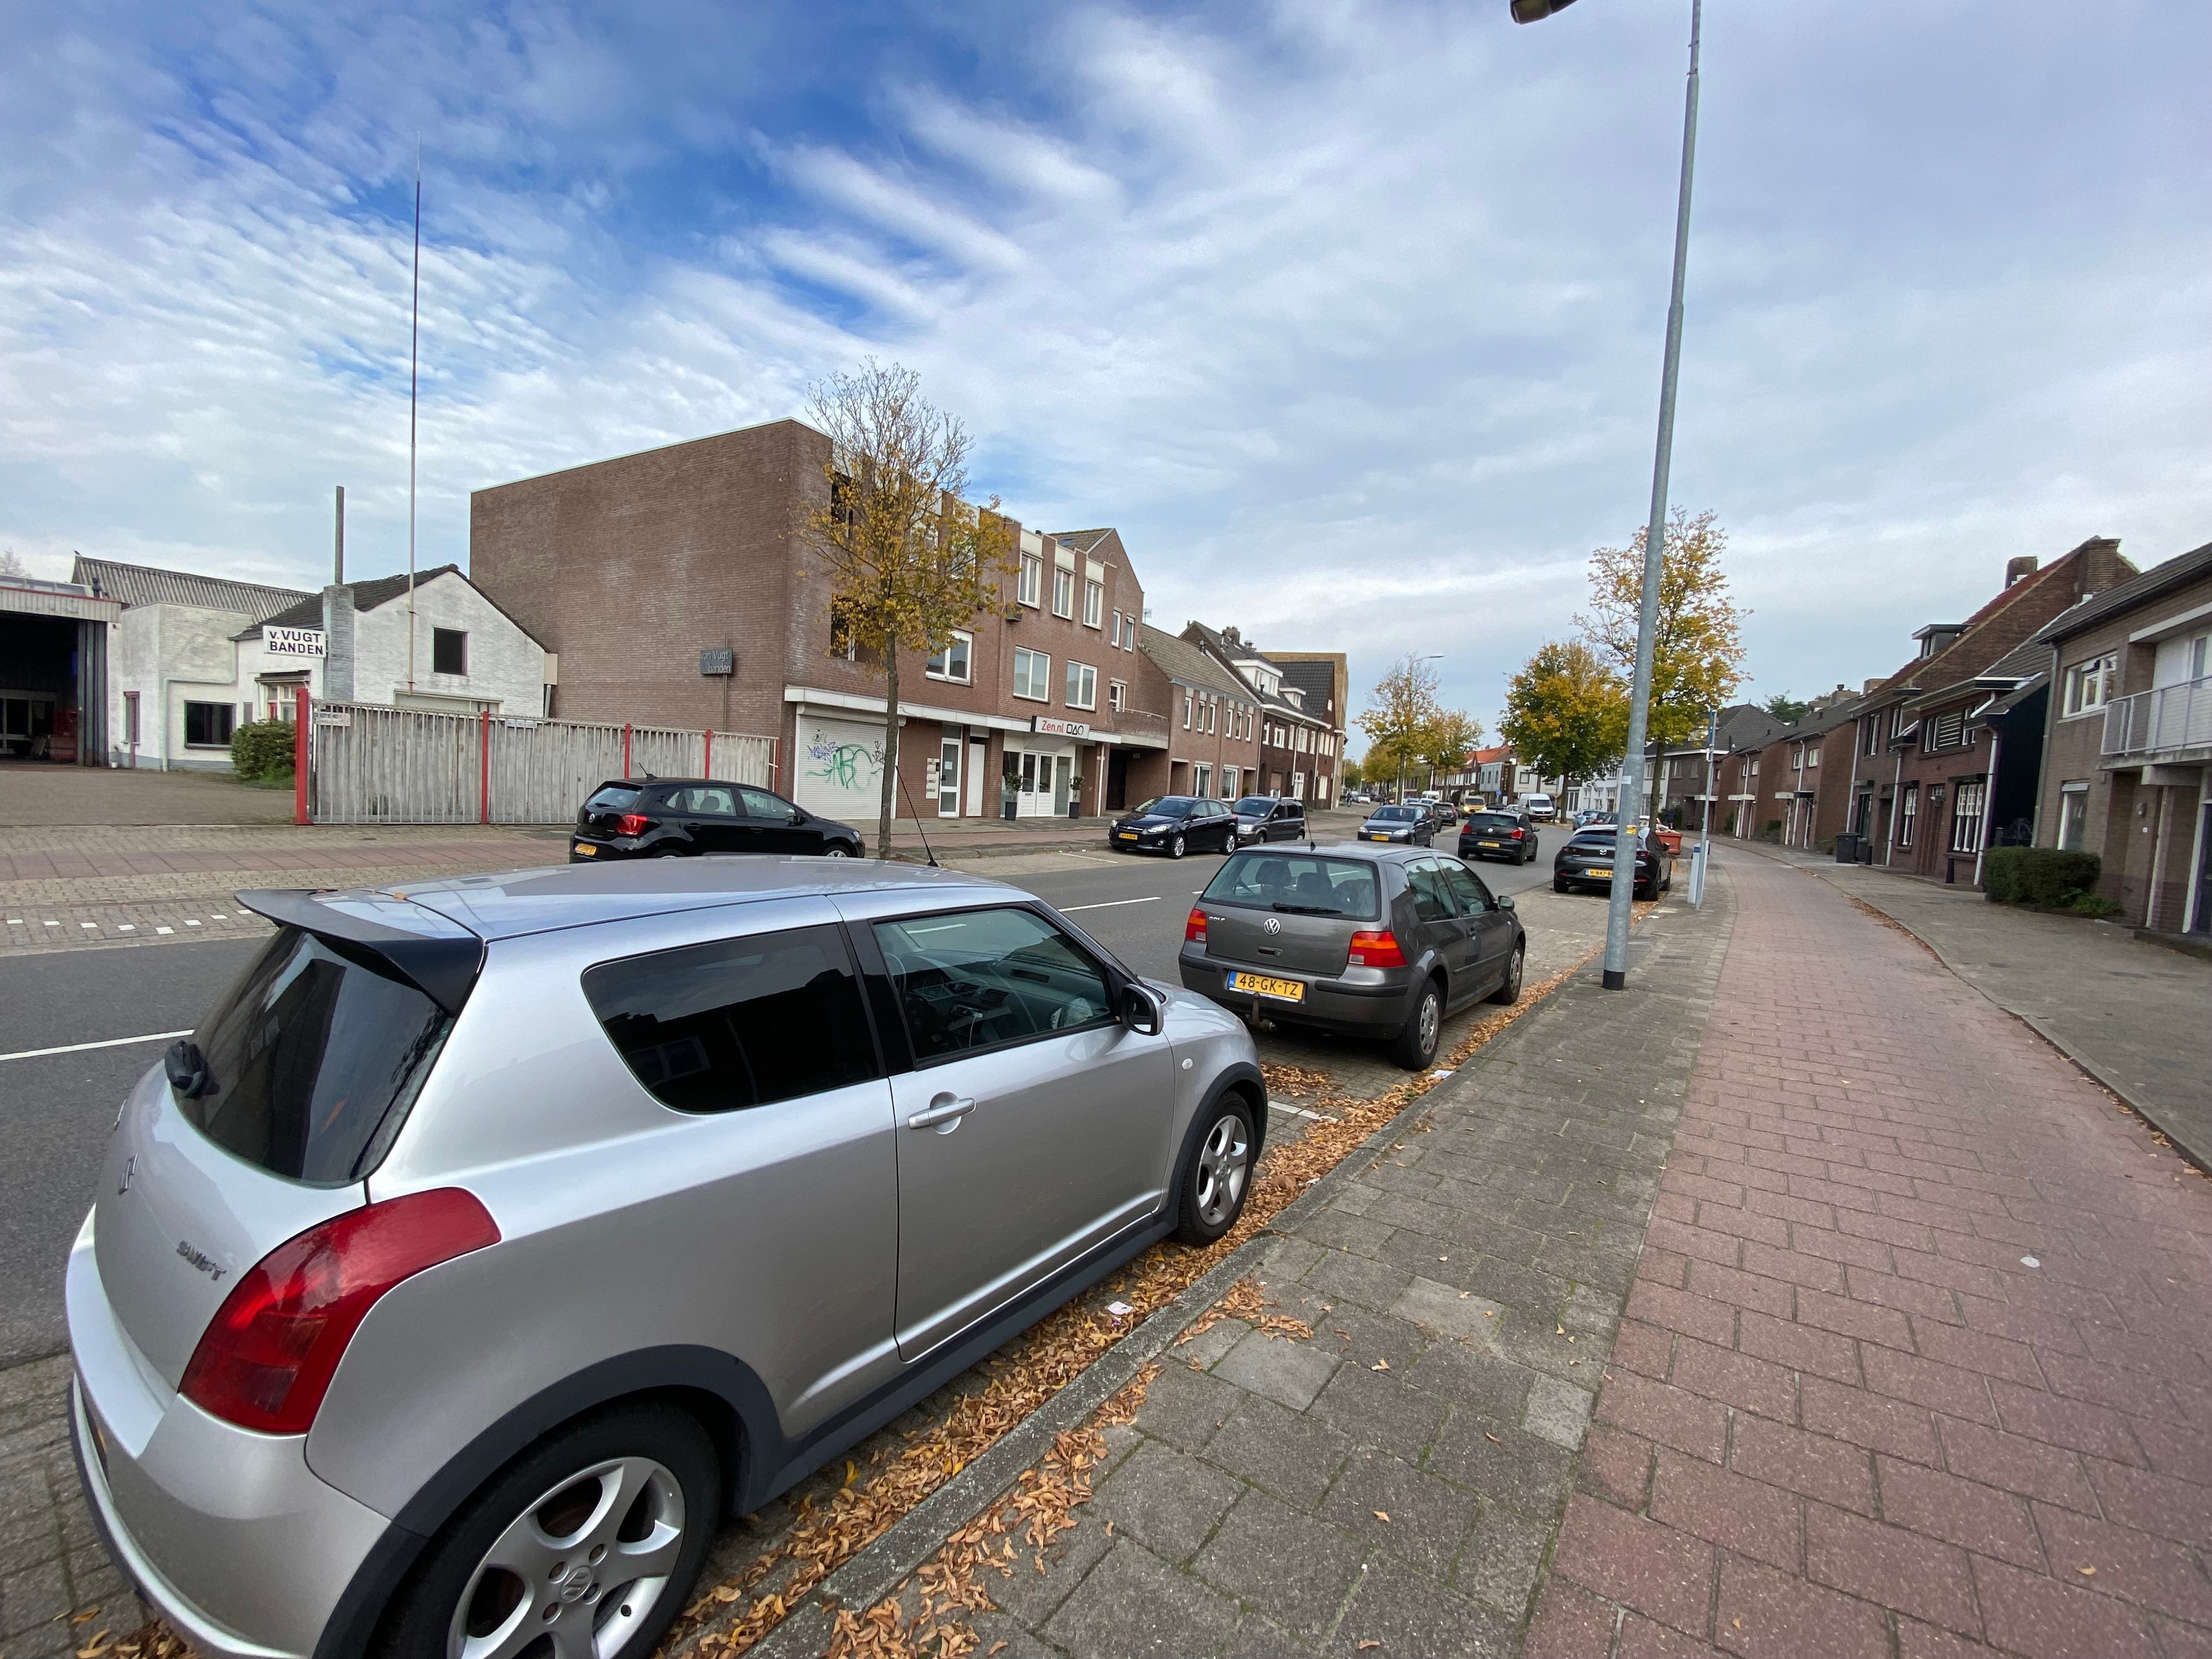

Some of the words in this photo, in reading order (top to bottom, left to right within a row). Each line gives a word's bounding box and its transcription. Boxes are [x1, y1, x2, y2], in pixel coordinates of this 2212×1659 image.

[281, 630, 321, 643] VUGT
[270, 641, 323, 655] BANDEN
[713, 650, 729, 662] Vugt
[708, 662, 731, 674] banden
[1041, 720, 1064, 733] Zen.nl
[1239, 975, 1299, 996] 48-GK-TZ
